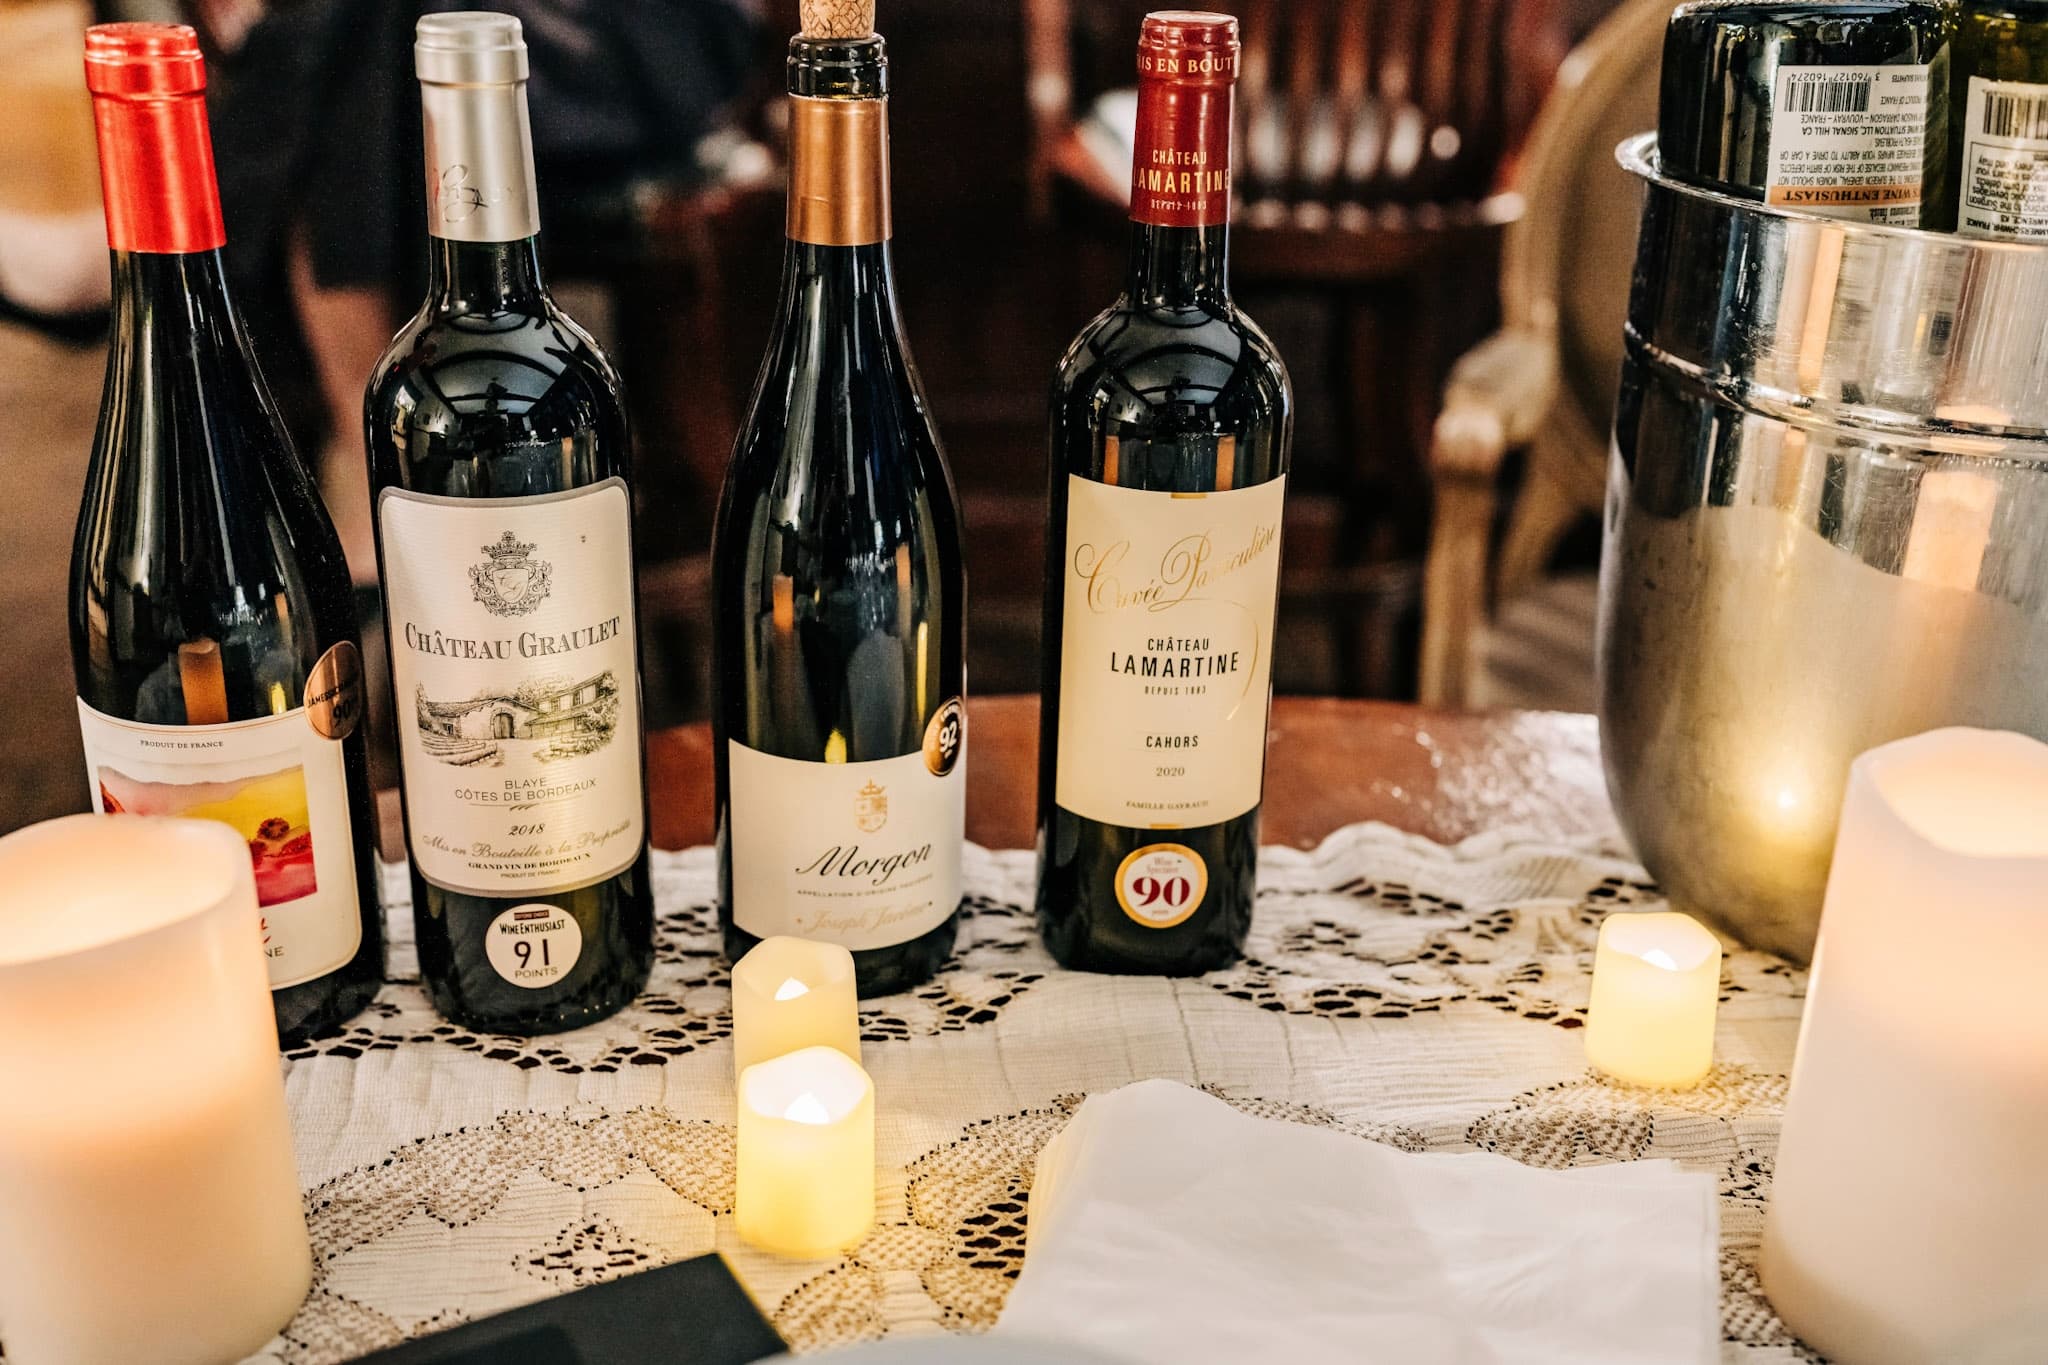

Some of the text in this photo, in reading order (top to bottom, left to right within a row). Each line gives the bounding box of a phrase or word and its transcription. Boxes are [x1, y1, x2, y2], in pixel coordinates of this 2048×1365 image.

[1138, 55, 1232, 74] IS EN BOUT
[1792, 72, 1880, 82] 3 760127 160274
[1801, 114, 1826, 123] FRANCE
[1833, 114, 1864, 123] VOUVRAY
[1870, 114, 1900, 122] DARRAGON
[1802, 127, 1812, 136] CA
[1815, 127, 1830, 135] HILL
[1832, 127, 1858, 135] SIGNAL
[1874, 126, 1906, 135] SITUATION
[1152, 148, 1207, 165] CHÂTEAU
[1780, 152, 1788, 160] OR
[1792, 152, 1803, 160] CAR
[1806, 152, 1810, 160] A
[1812, 152, 1828, 160] DRIVE
[1831, 152, 1838, 160] TO
[1841, 151, 1860, 160] ABILITY
[1862, 151, 1875, 159] YOUR
[1806, 164, 1822, 173] BIRTH
[1823, 164, 1831, 173] OF
[1833, 164, 1844, 173] RISK
[1846, 164, 1855, 173] THE
[1858, 164, 1864, 173] OF
[1865, 163, 1886, 172] BECAUSE
[1133, 169, 1229, 193] LAMARTINE
[1778, 177, 1789, 185] NOT
[1792, 177, 1814, 185] SHOULD
[1816, 177, 1837, 185] WOMEN
[1866, 176, 1887, 184] SURGEON
[1783, 190, 1878, 201] ENTHUSIAST
[1883, 189, 1909, 200] WINE
[1075, 525, 1277, 614] Cuvée Paculière
[405, 615, 621, 660] CHÂTEAU GRAULET
[1147, 636, 1210, 652] CHÂTEAU
[1111, 651, 1240, 679] LAMARTINE
[1145, 685, 1179, 695] DEPUIS
[940, 721, 958, 752] 92
[140, 740, 174, 749] PRODUIT
[191, 741, 224, 749] FRANCE
[1146, 735, 1199, 748] CAHORS
[1156, 767, 1185, 777] 2020
[505, 777, 547, 789] BLAYE
[455, 778, 597, 801] CÔTES DE BORDEAUX
[1126, 801, 1164, 810] FAMILLE
[508, 823, 546, 836] 2018
[423, 834, 450, 852] Mis
[452, 847, 467, 855] en
[471, 842, 544, 859] Bouteille
[468, 861, 502, 871] GRAND
[524, 862, 538, 870] DE
[540, 853, 592, 868] BORDEAUX
[795, 843, 932, 886] Morgon
[1133, 876, 1191, 907] 90
[514, 939, 550, 969] 91
[515, 967, 558, 979] POINTS
